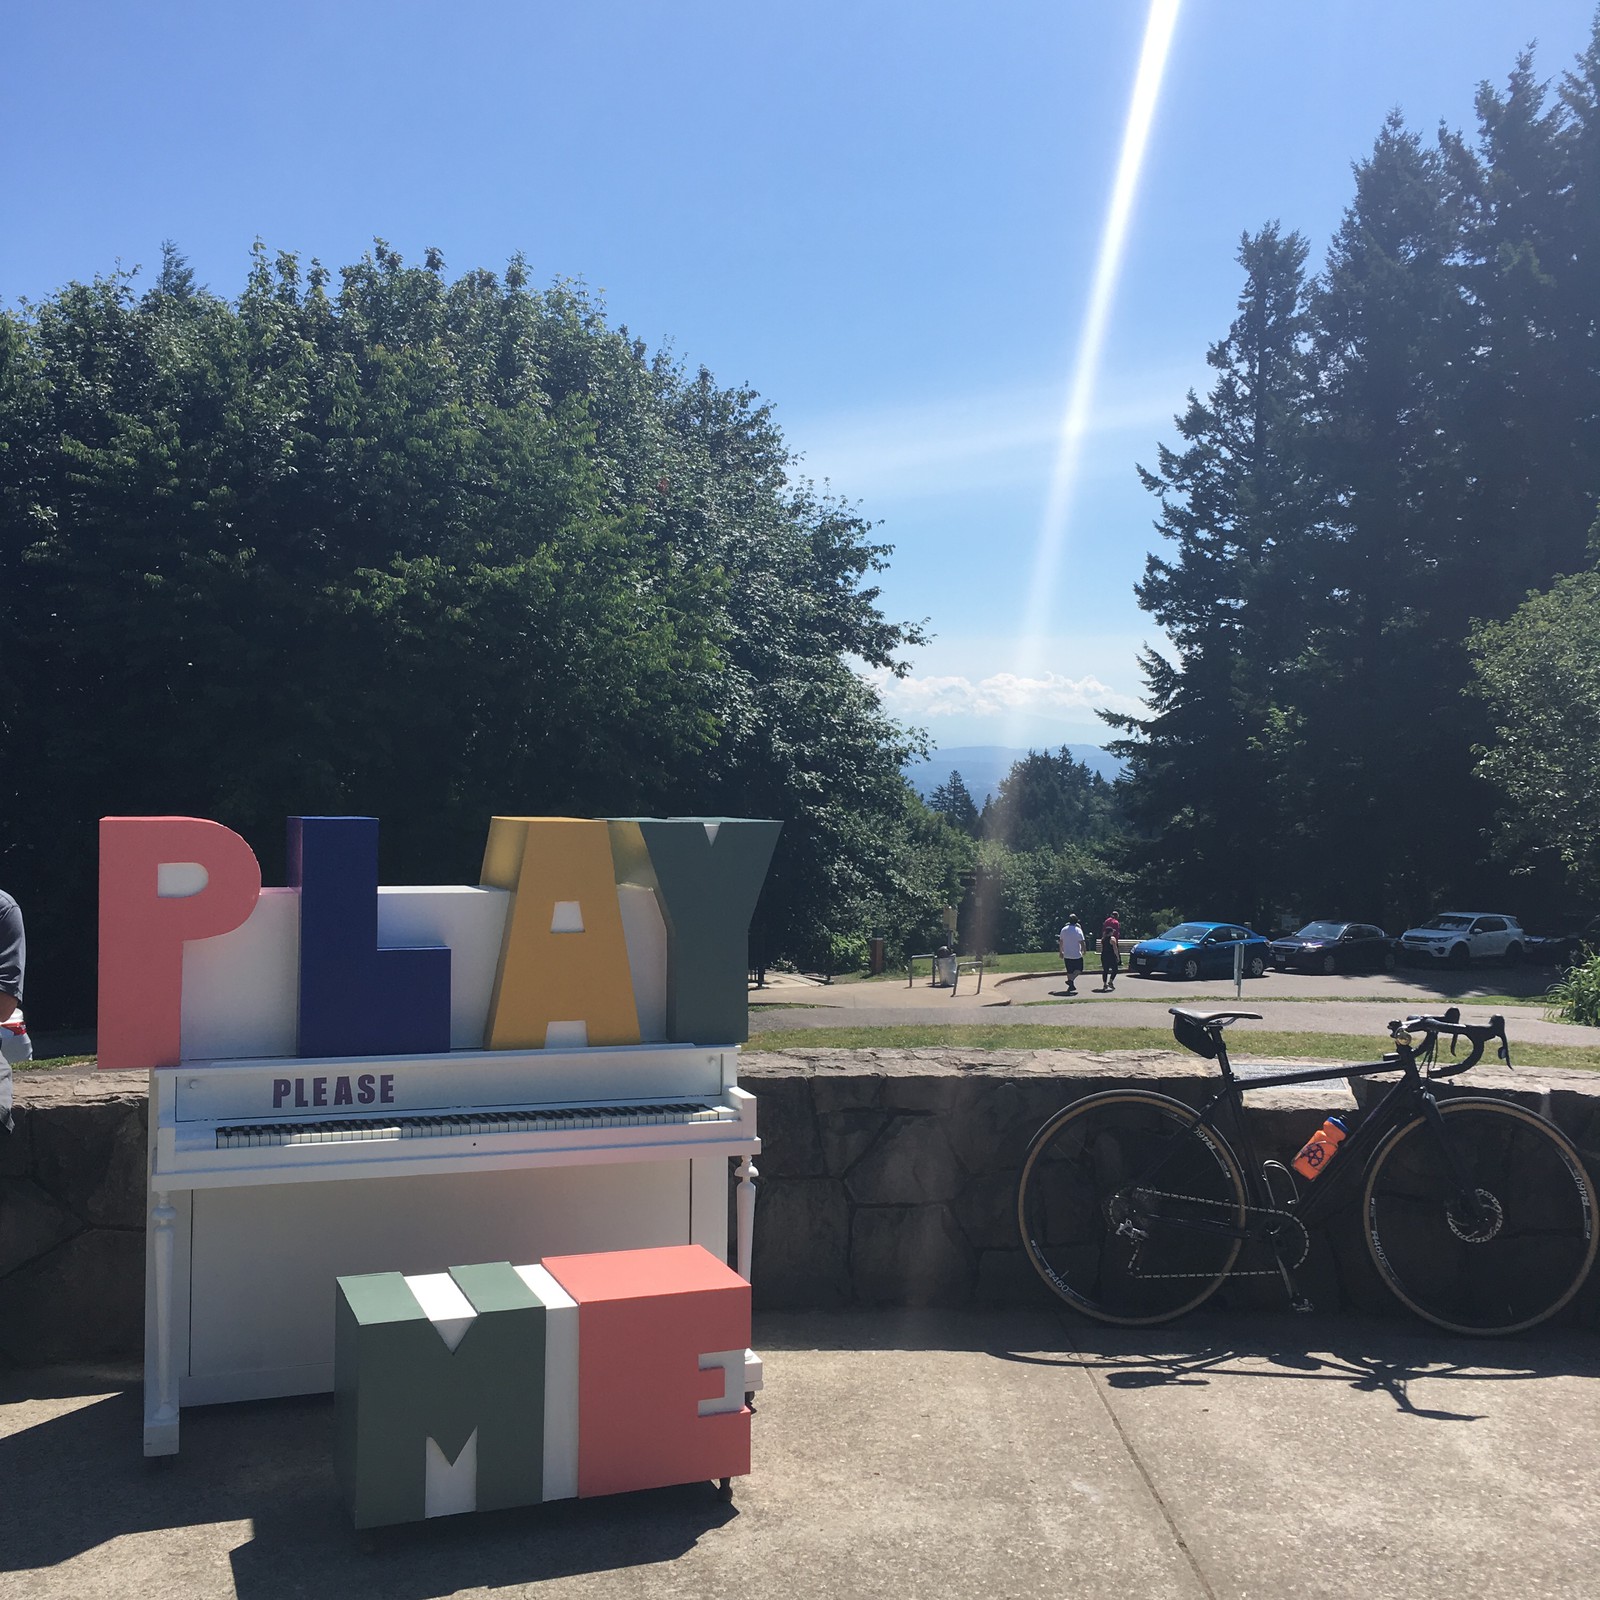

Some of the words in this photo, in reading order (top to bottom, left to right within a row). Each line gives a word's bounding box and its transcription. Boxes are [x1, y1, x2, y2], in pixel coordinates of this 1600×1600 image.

[97, 815, 784, 1069] PLAY
[272, 1074, 395, 1109] PLEASE
[354, 1287, 752, 1529] ME
